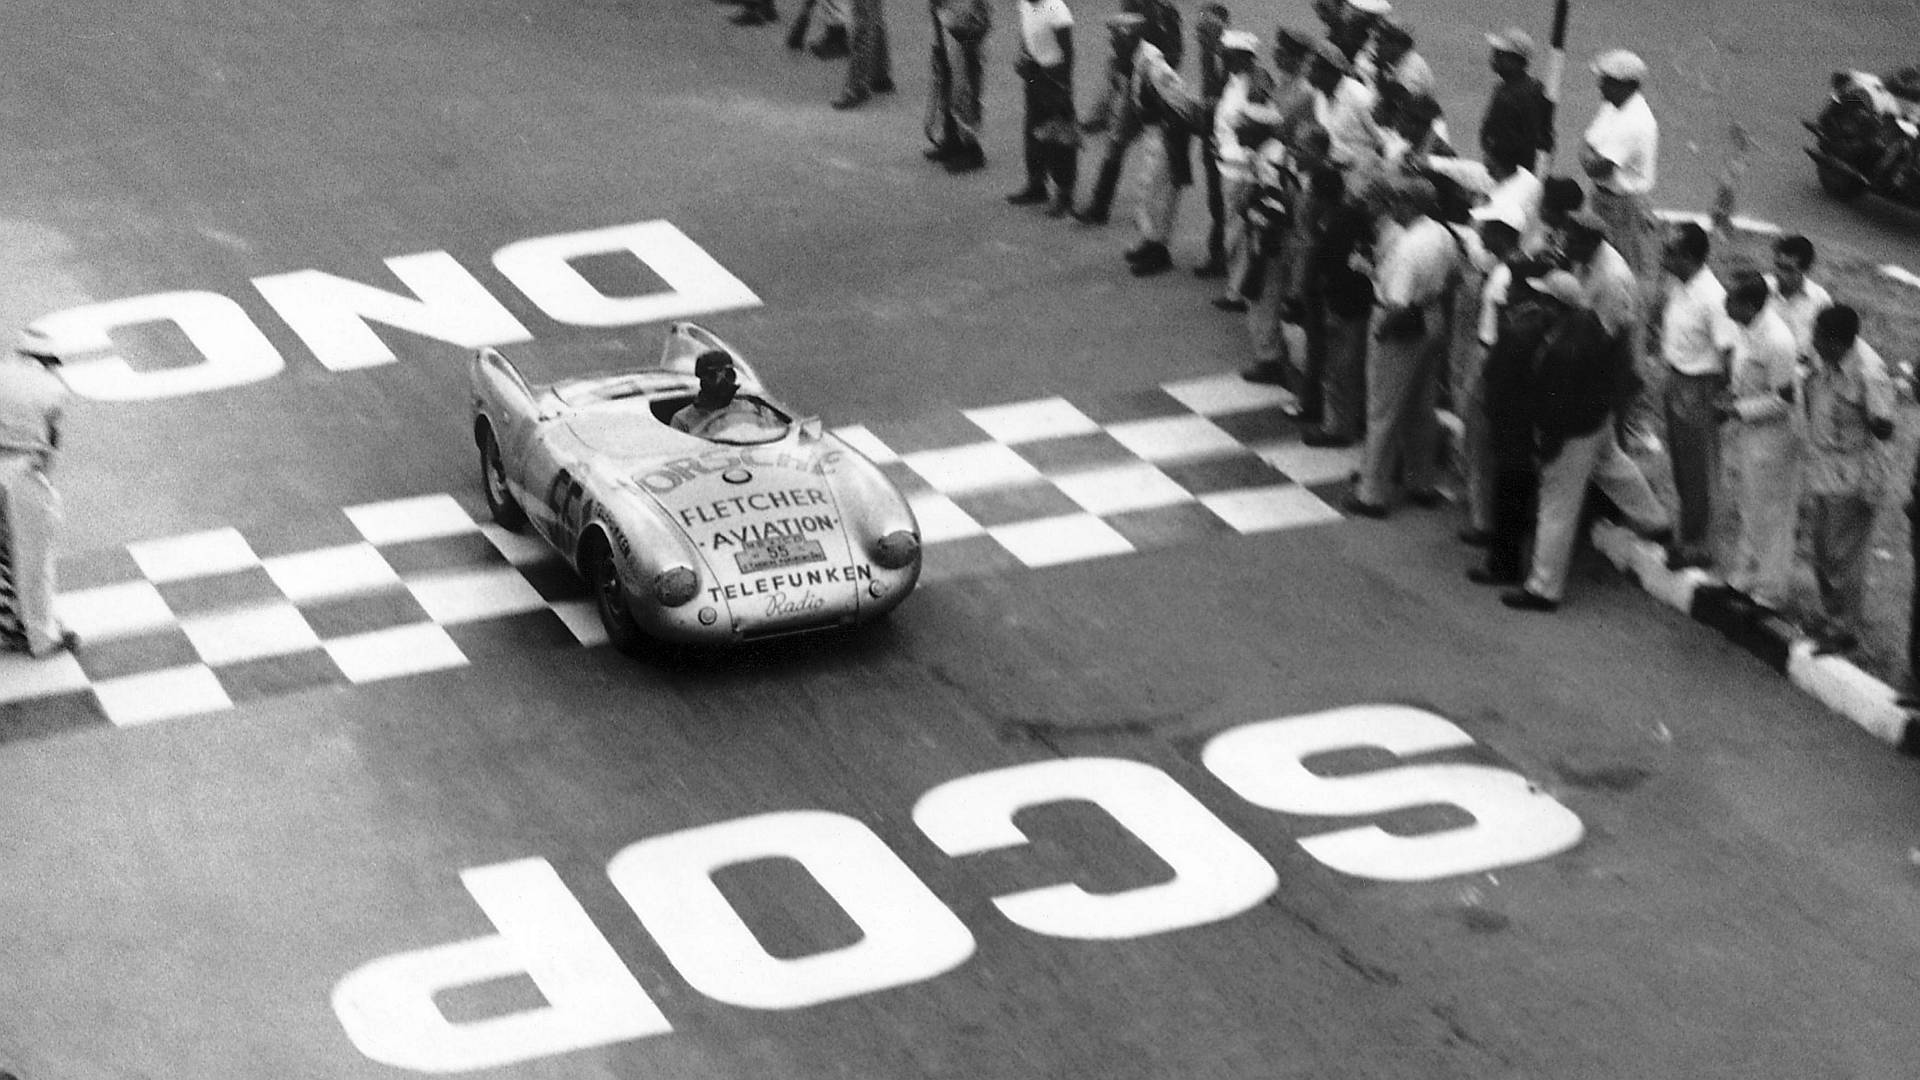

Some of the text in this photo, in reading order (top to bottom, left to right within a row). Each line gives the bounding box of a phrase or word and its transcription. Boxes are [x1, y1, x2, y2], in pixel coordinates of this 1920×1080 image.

[679, 488, 828, 527] FLETCHER
[707, 564, 872, 603] TELEFUNKEN
[765, 590, 824, 619] Radio
